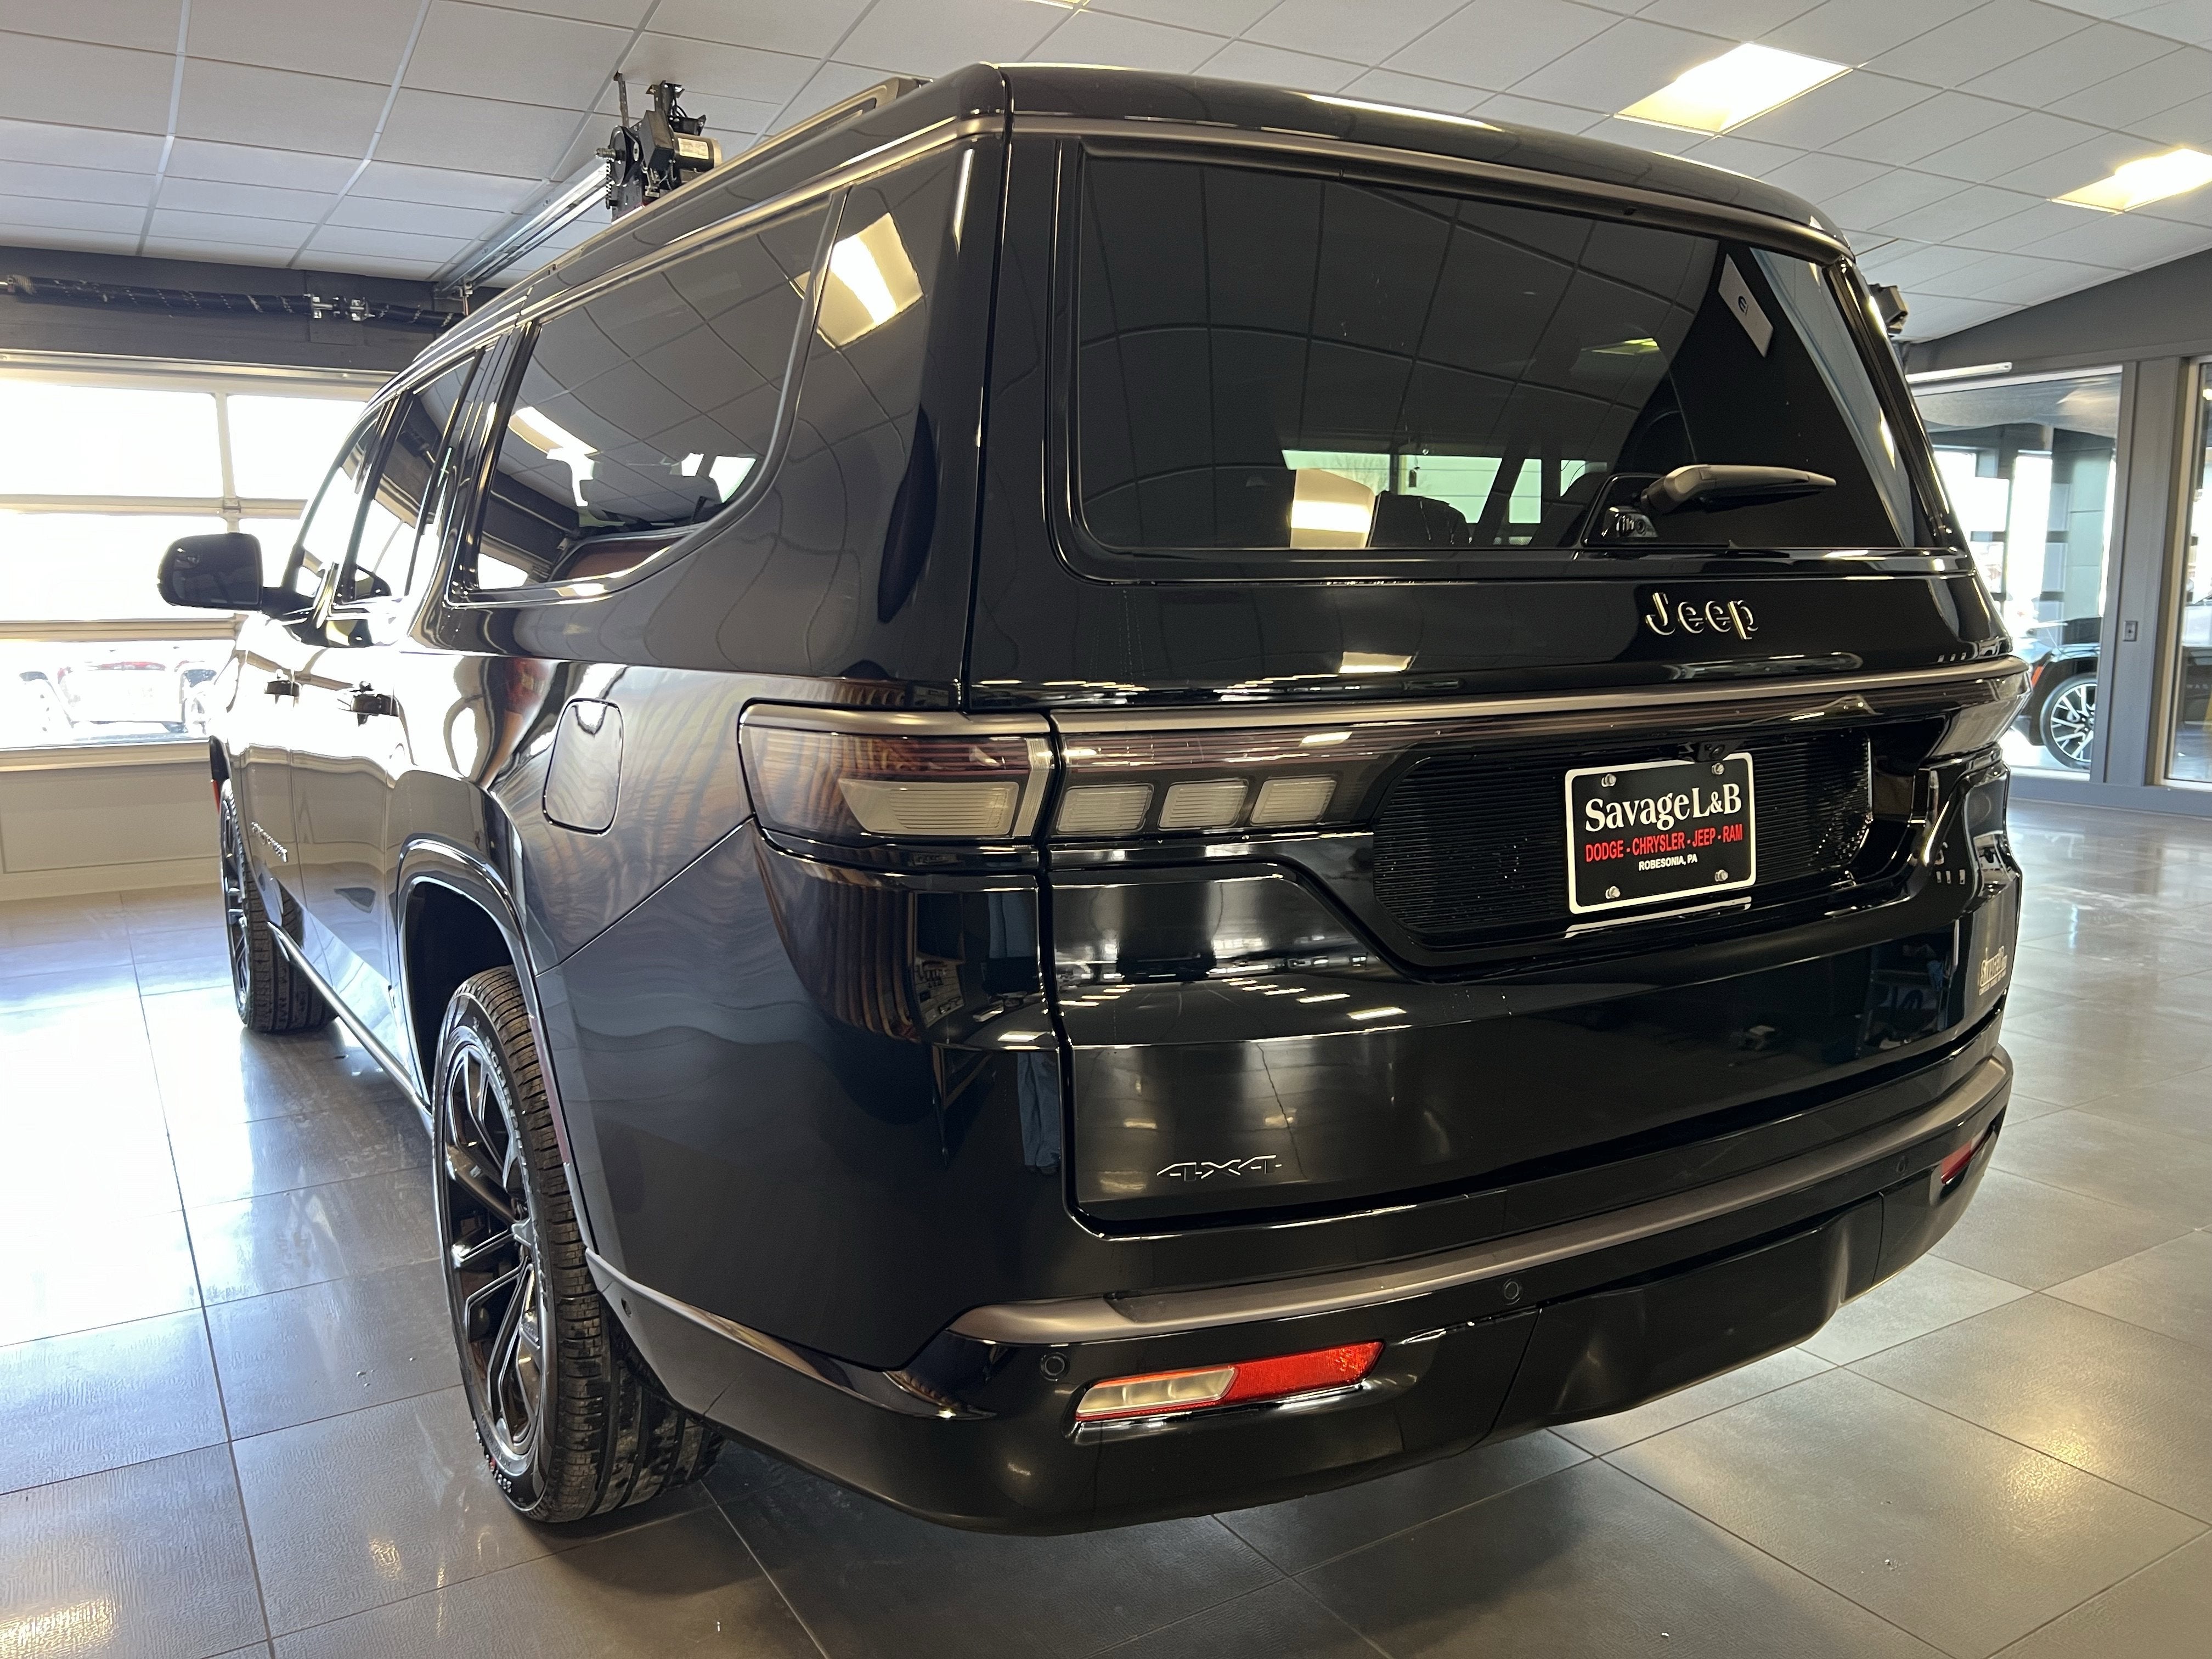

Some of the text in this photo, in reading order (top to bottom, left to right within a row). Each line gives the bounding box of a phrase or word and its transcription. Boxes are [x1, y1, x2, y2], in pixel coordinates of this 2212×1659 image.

[1646, 592, 1758, 640] Jeep
[1585, 839, 1624, 862] DODGE
[1632, 831, 1685, 856] CHRYSLER
[1692, 827, 1716, 848] JEEP
[1722, 823, 1743, 843] RAM
[1638, 853, 1698, 871] ROBESONIA, PA
